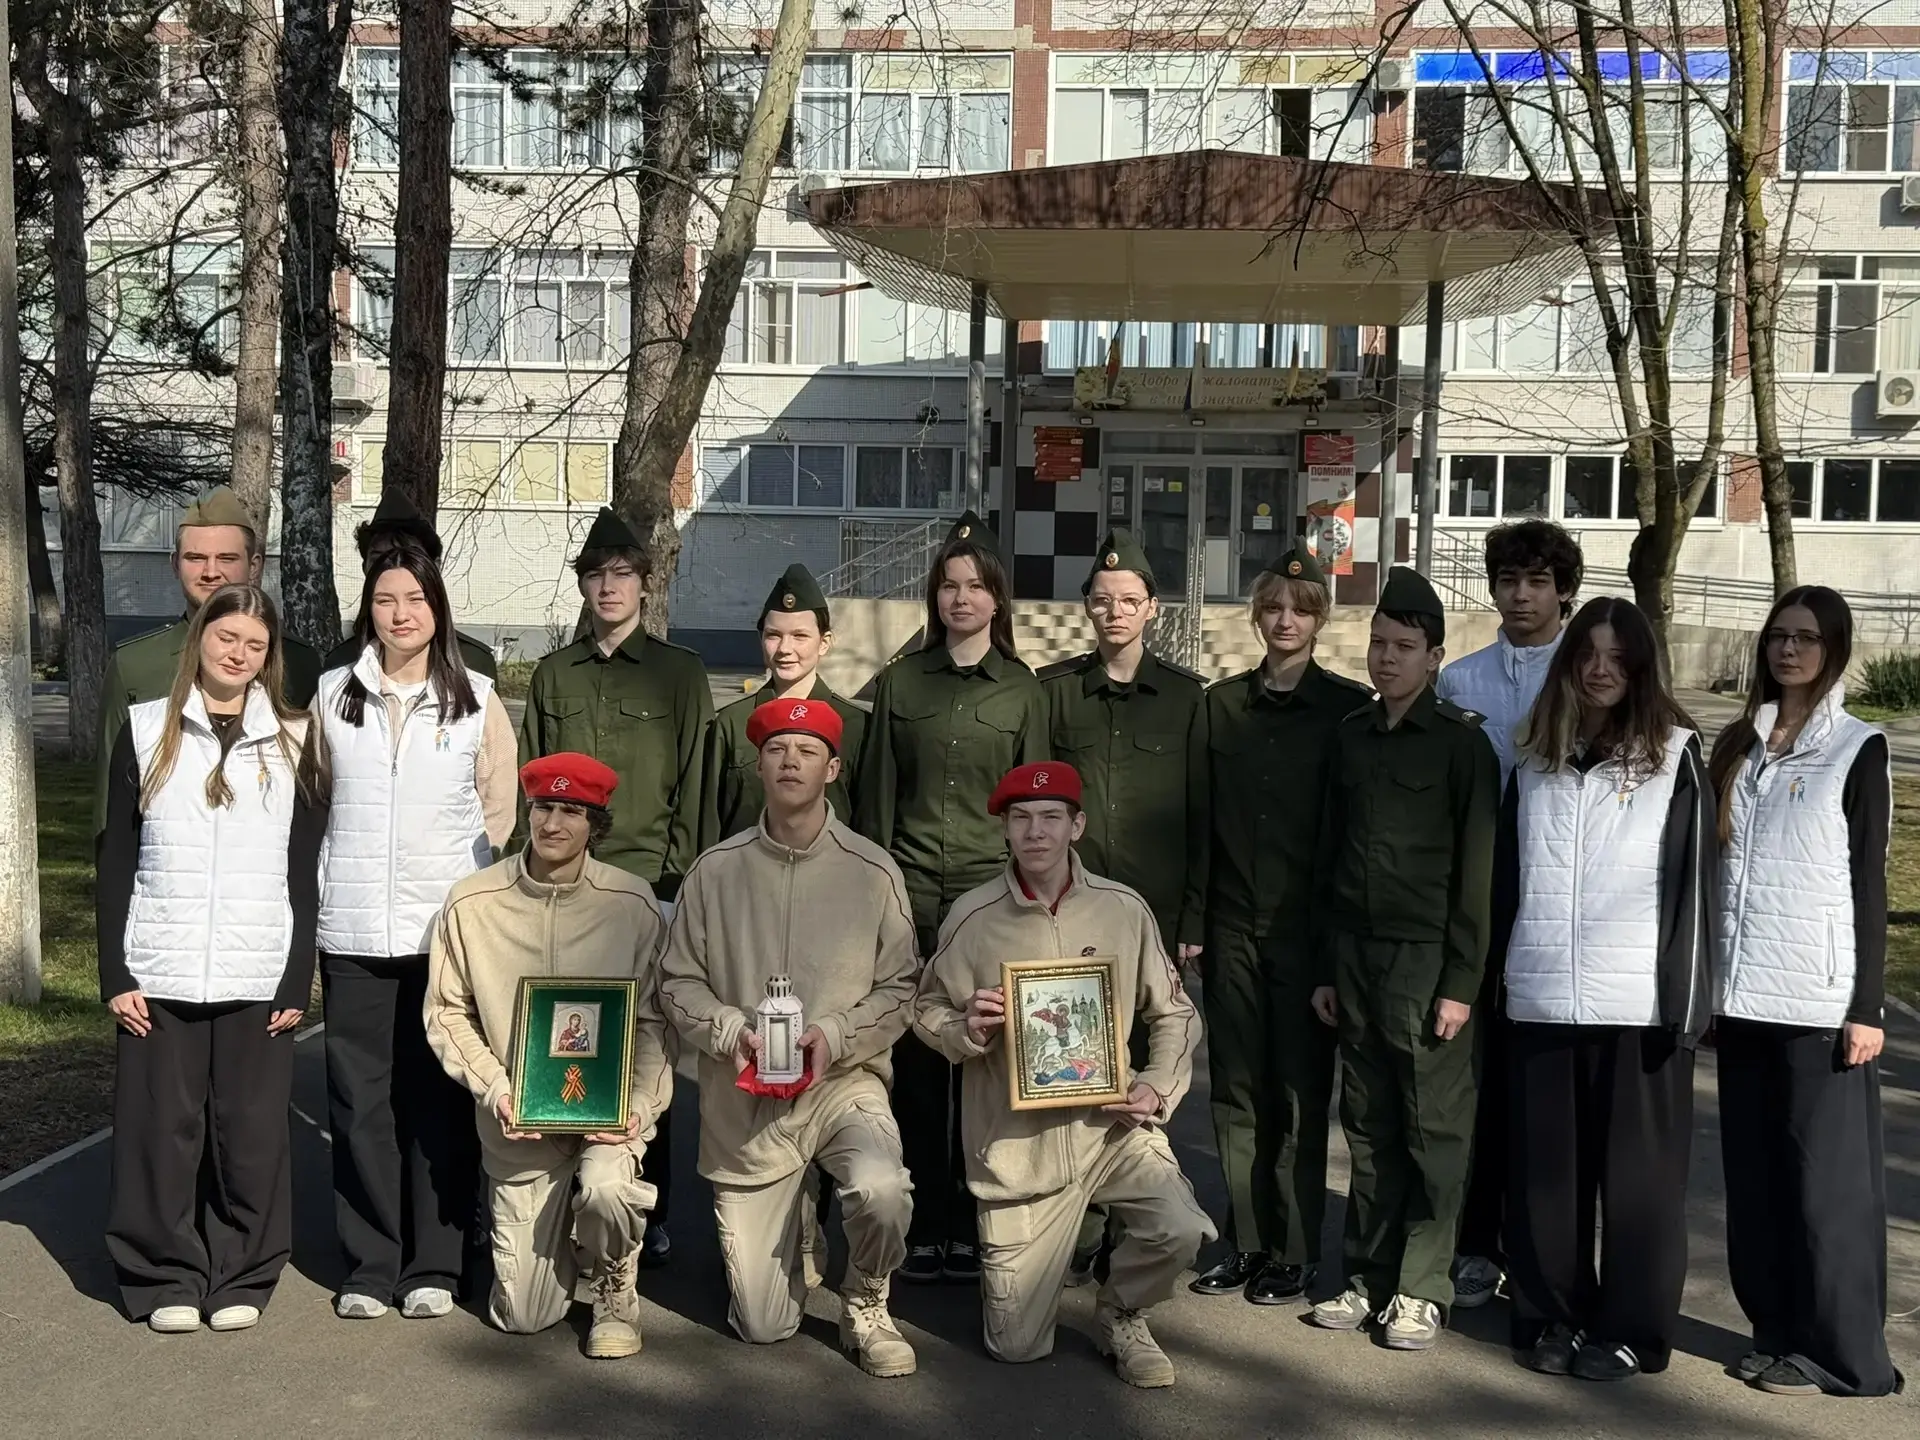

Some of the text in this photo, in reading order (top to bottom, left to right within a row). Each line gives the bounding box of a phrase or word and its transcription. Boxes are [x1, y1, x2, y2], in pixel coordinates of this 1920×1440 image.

[1139, 372, 1179, 389] Добро
[1163, 395, 1186, 405] ми
[1201, 392, 1263, 405] знаний!
[1311, 466, 1354, 477] ПОМНИМ!
